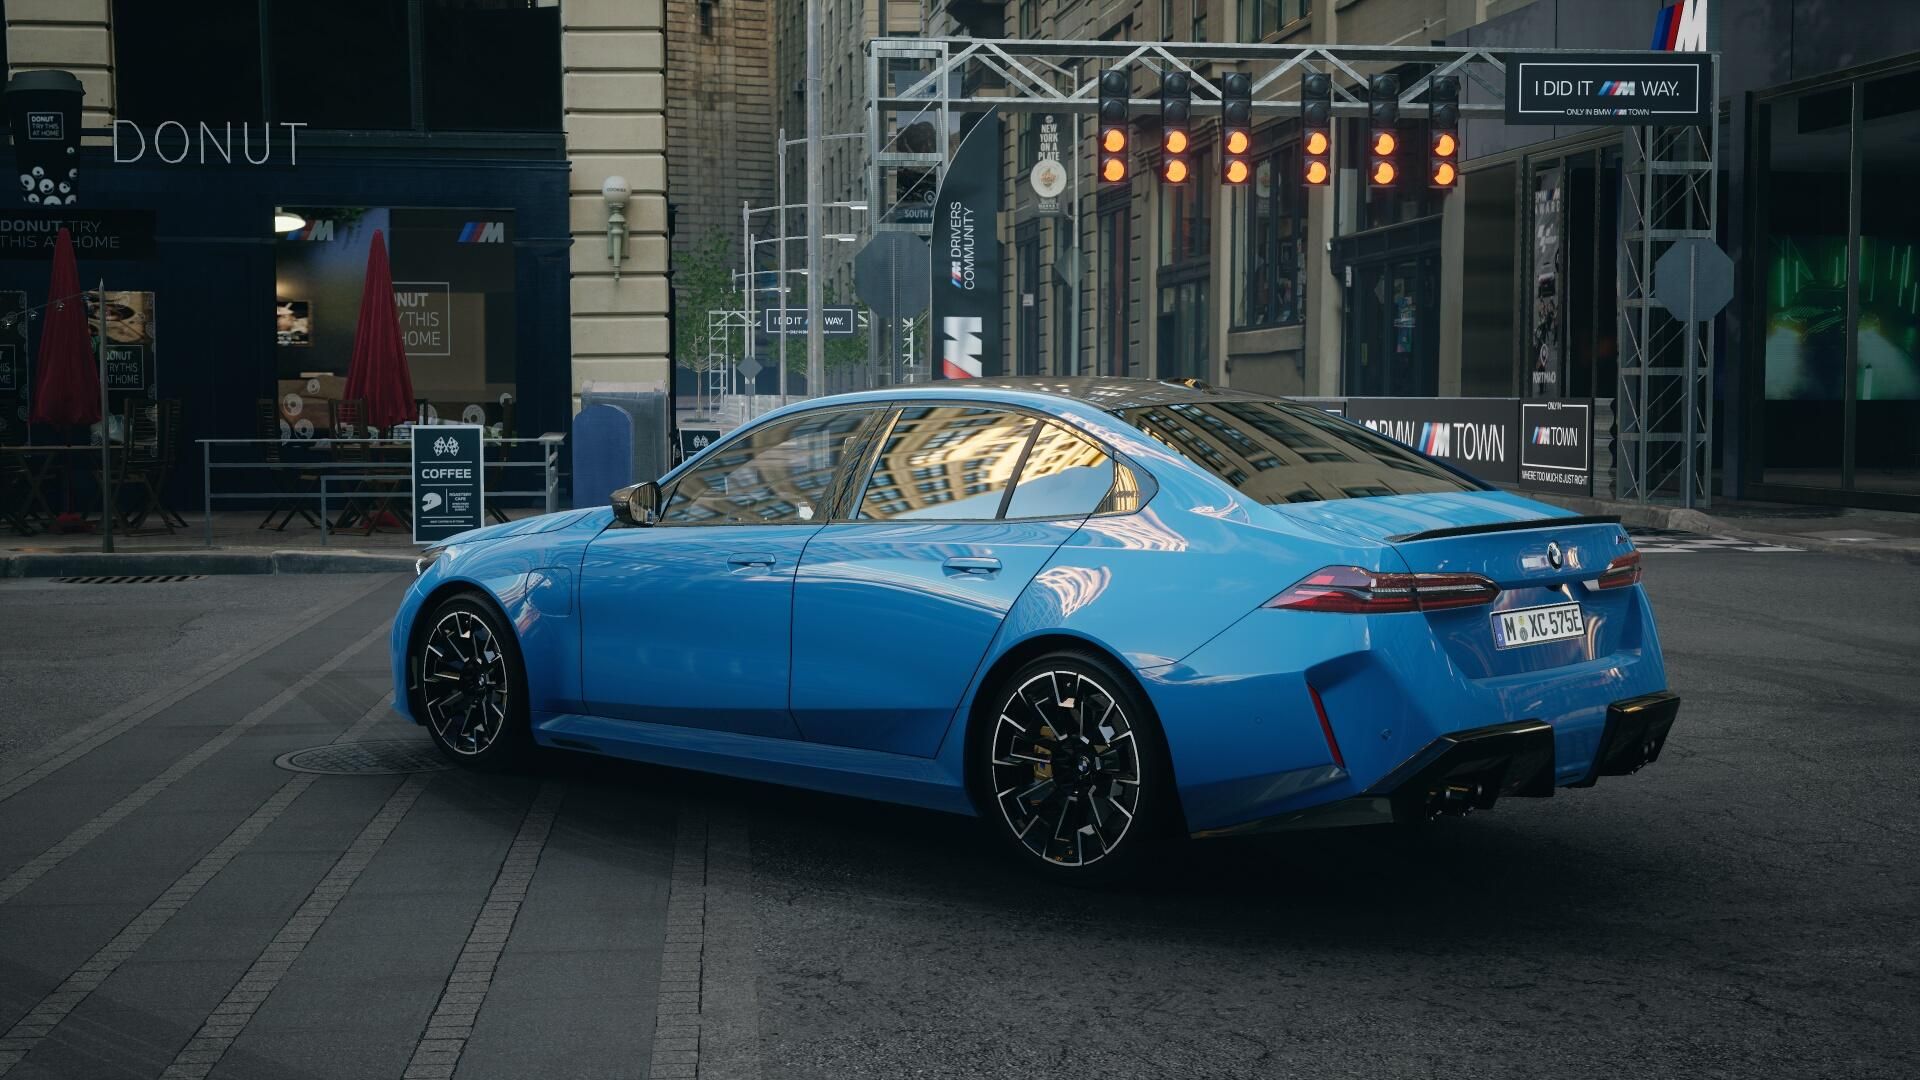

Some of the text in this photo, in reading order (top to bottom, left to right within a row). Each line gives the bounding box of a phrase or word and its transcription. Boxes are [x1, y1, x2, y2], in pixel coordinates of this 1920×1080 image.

[1651, 0, 1707, 51] M
[1535, 80, 1539, 96] I
[1543, 80, 1572, 96] DID
[1577, 80, 1593, 96] IT
[1641, 80, 1680, 97] WAY.
[1566, 108, 1584, 116] ONLY
[1585, 108, 1592, 116] IN
[1593, 108, 1612, 116] BMW
[1628, 108, 1650, 116] TOWN
[31, 115, 55, 123] DONUT
[1041, 123, 1058, 133] NEW
[113, 119, 308, 165] DONUT
[1039, 133, 1059, 143] YORK
[1040, 142, 1058, 152] ON A
[1038, 151, 1060, 161] PLATE
[904, 209, 929, 218] SOUTH
[0, 219, 102, 233] DONUT TRY
[950, 201, 961, 258] DRIVERS
[0, 235, 38, 248] THIS
[963, 207, 975, 290] COMMUNITY
[394, 291, 429, 308] NUT
[405, 311, 440, 327] THIS
[794, 316, 803, 325] IT
[824, 316, 844, 326] WAY.
[119, 362, 138, 373] THIS
[115, 374, 139, 385] HOME
[1547, 402, 1557, 410] ONLY
[1453, 422, 1505, 463] TOWN
[1551, 426, 1578, 447] TOWN
[421, 468, 472, 479] COFFEE
[1521, 469, 1536, 480] WHERE
[1536, 471, 1546, 481] TOO
[1546, 471, 1558, 482] MUCH
[1558, 473, 1563, 483] IS
[1563, 474, 1574, 483] JUST
[1503, 616, 1517, 641] M
[1527, 613, 1548, 638] XC
[1549, 608, 1582, 635] 575E
